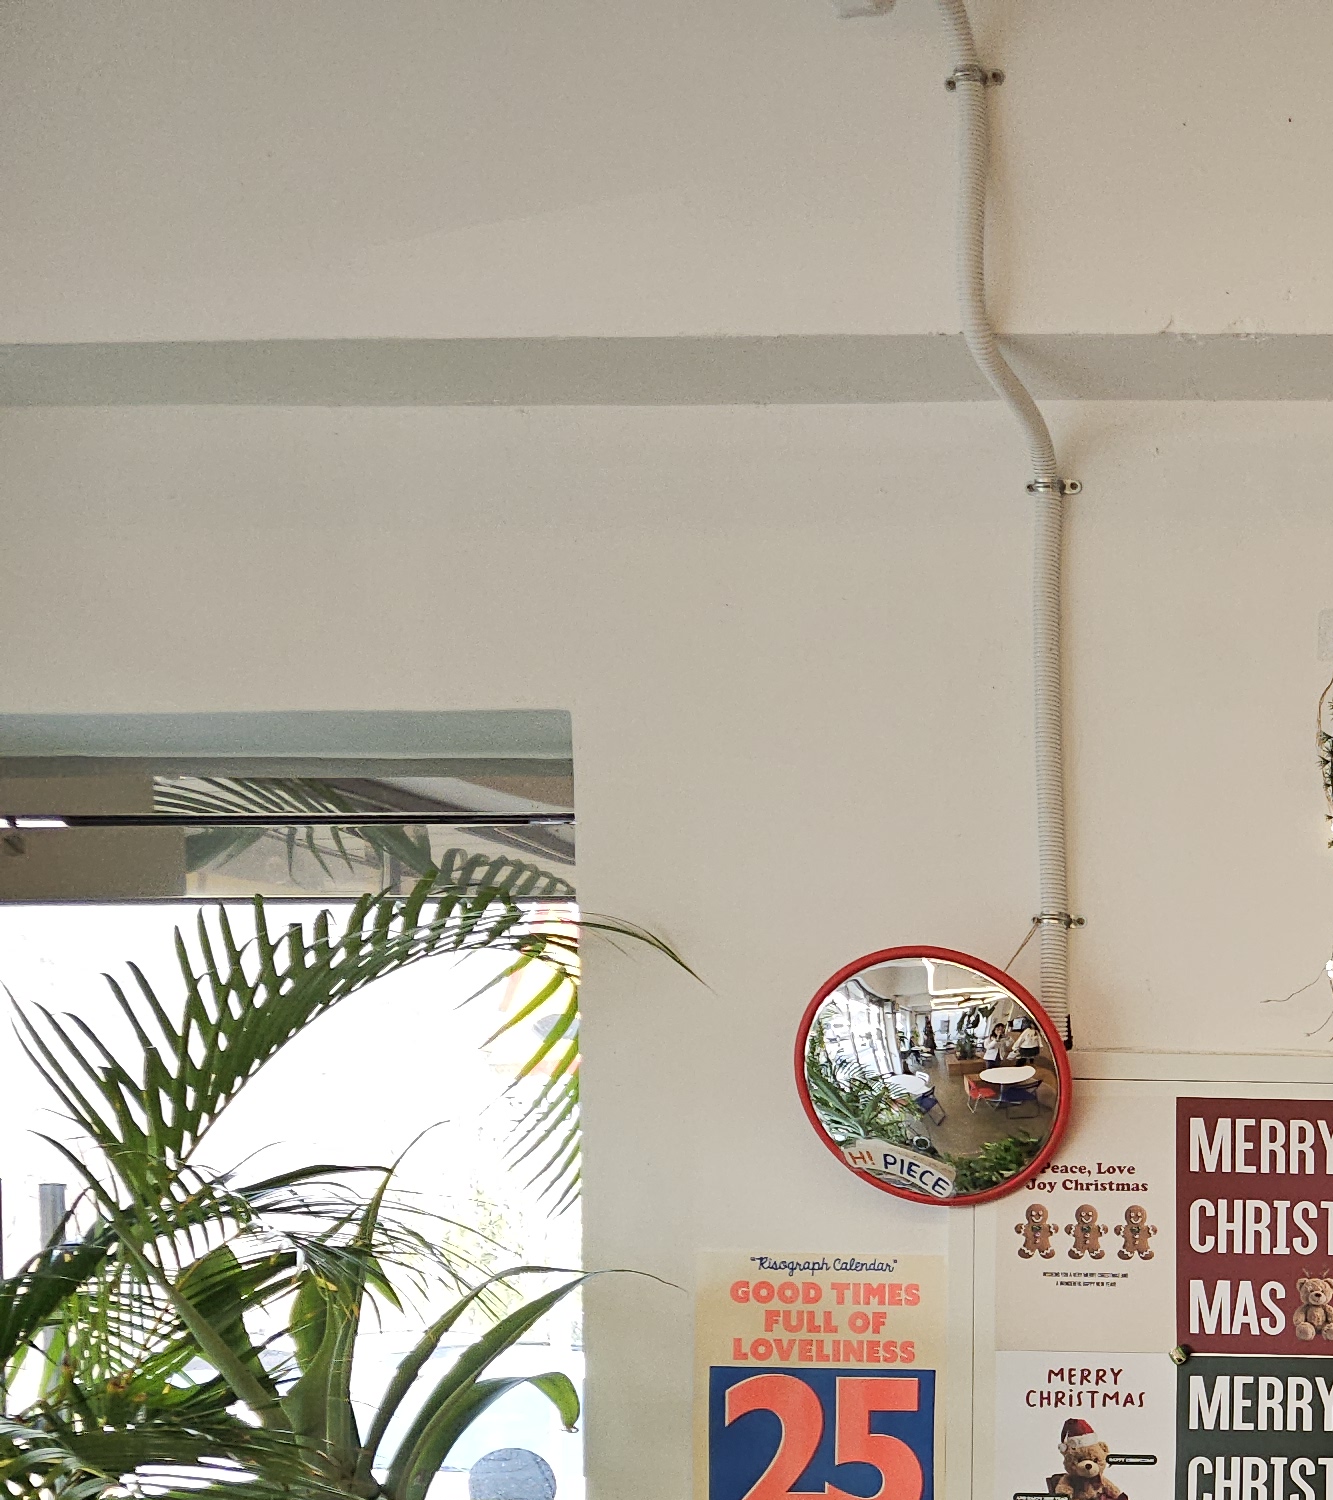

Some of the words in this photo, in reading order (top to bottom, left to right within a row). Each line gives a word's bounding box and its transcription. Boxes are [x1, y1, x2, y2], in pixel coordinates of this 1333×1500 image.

[882, 1152, 950, 1197] PIECE
[1096, 1162, 1136, 1176] Love
[1025, 1178, 1055, 1194] Joy
[1061, 1178, 1149, 1193] Christmas
[729, 1280, 823, 1305] GOOD
[830, 1282, 921, 1307] TIMES
[1189, 1279, 1286, 1336] MAS
[764, 1309, 839, 1334] FULL
[847, 1310, 888, 1335] OF
[732, 1337, 916, 1364] LOVELINESS
[1047, 1367, 1124, 1386] MERRY
